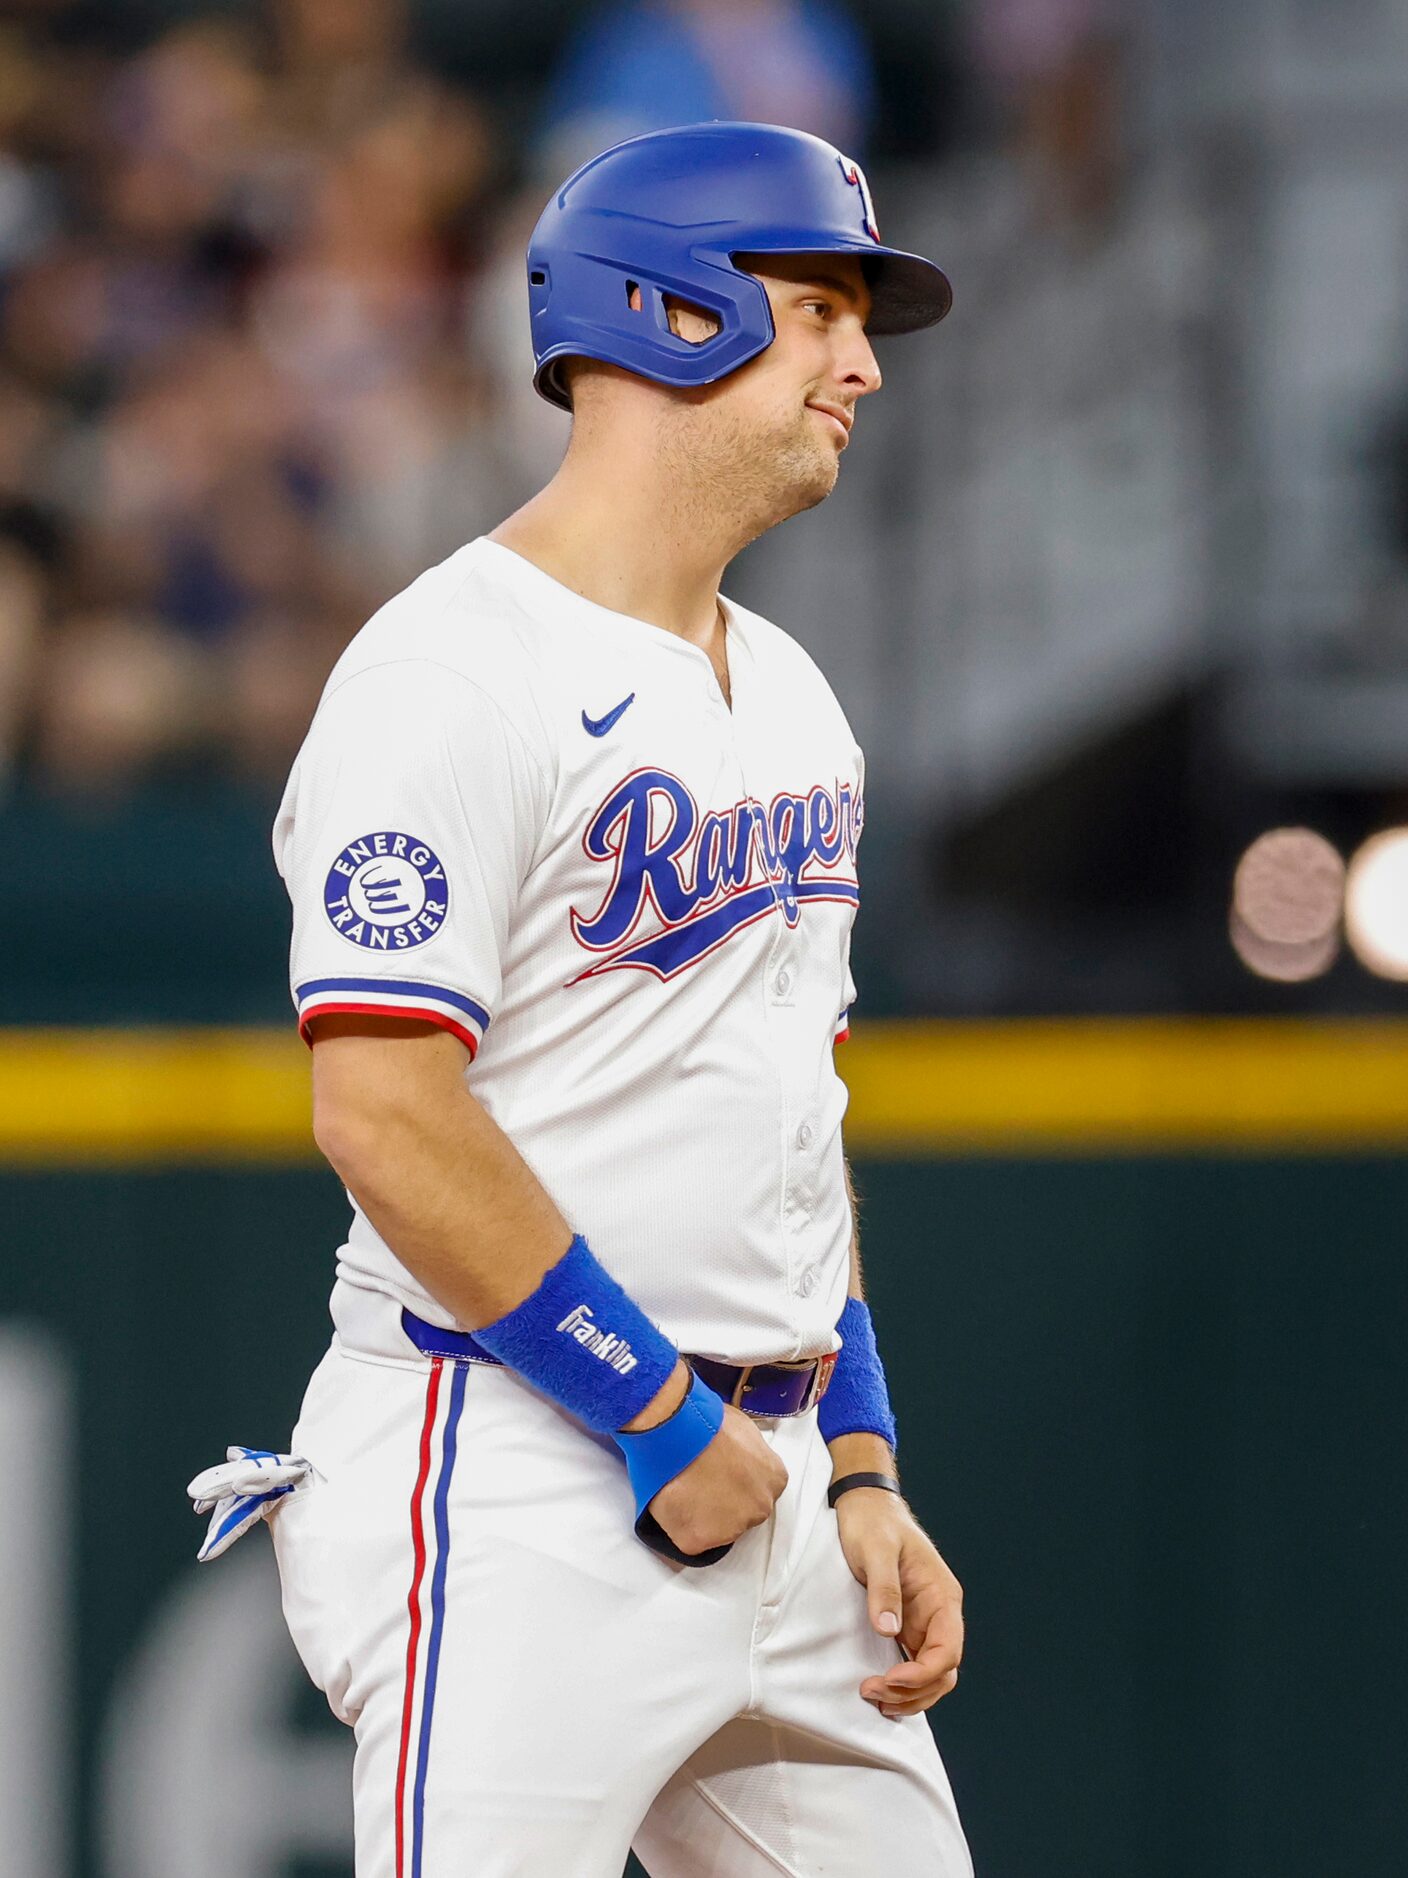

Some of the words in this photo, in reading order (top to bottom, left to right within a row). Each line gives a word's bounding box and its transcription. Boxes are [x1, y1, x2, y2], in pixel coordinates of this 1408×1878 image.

[333, 834, 444, 877] ENERGY
[327, 895, 446, 950] TRANSFER
[555, 1304, 638, 1375] Franklin
